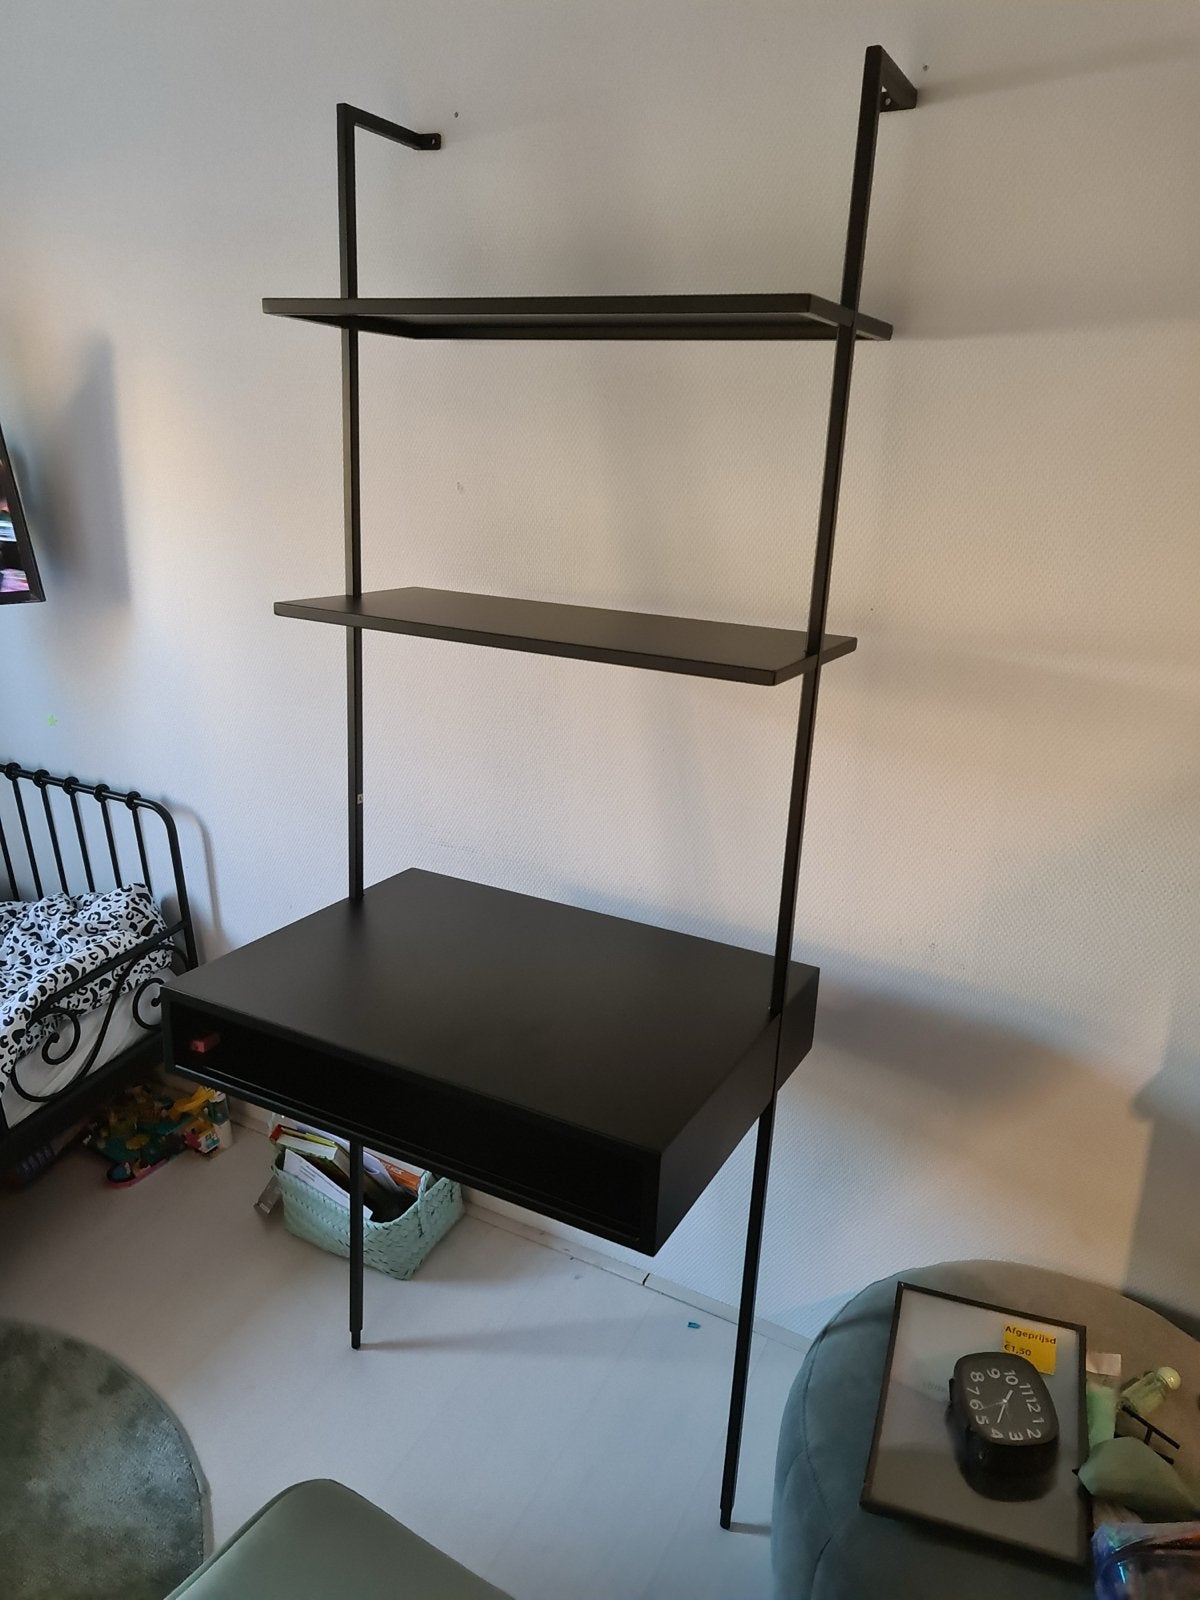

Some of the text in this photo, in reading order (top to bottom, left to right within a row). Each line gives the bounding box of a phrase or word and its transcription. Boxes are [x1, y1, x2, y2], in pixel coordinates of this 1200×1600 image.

[1005, 1326, 1056, 1344] Afgeprijsd
[1004, 1344, 1032, 1356] €1,50
[970, 1371, 985, 1382] 8
[987, 1368, 1001, 1379] 9
[1004, 1369, 1019, 1385] 10
[966, 1386, 980, 1395] 7
[1019, 1383, 1034, 1395] 11
[969, 1399, 984, 1410] 6
[1025, 1397, 1041, 1413] 12
[975, 1415, 989, 1425] 5
[990, 1428, 1004, 1439] 4
[1008, 1431, 1024, 1441] 3
[1026, 1428, 1041, 1439] 2
